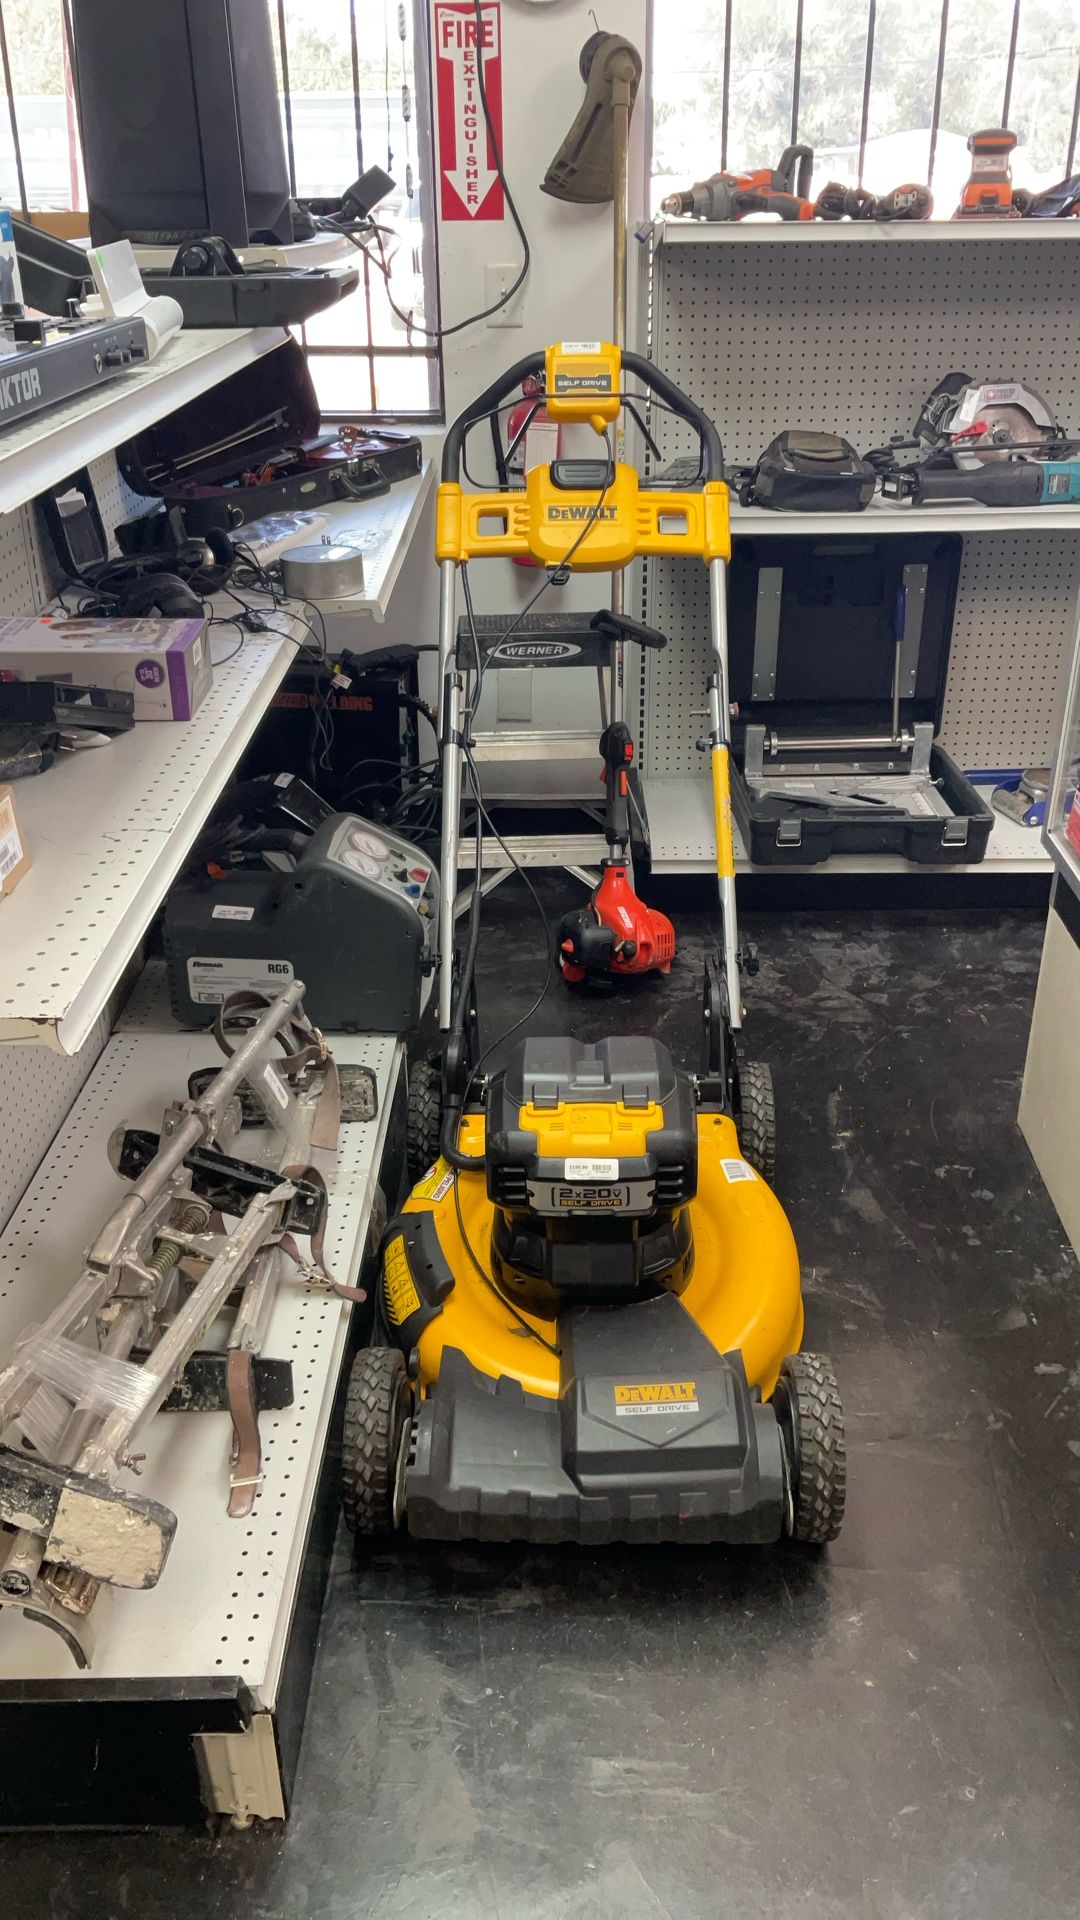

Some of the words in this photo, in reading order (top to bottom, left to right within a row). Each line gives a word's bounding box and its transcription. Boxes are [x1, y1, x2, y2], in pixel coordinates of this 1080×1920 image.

[442, 20, 494, 48] FIRE
[463, 51, 478, 204] EXTINGUISHER
[506, 646, 563, 655] WERNER
[268, 964, 289, 974] RG6
[657, 1404, 690, 1412] DRIVE
